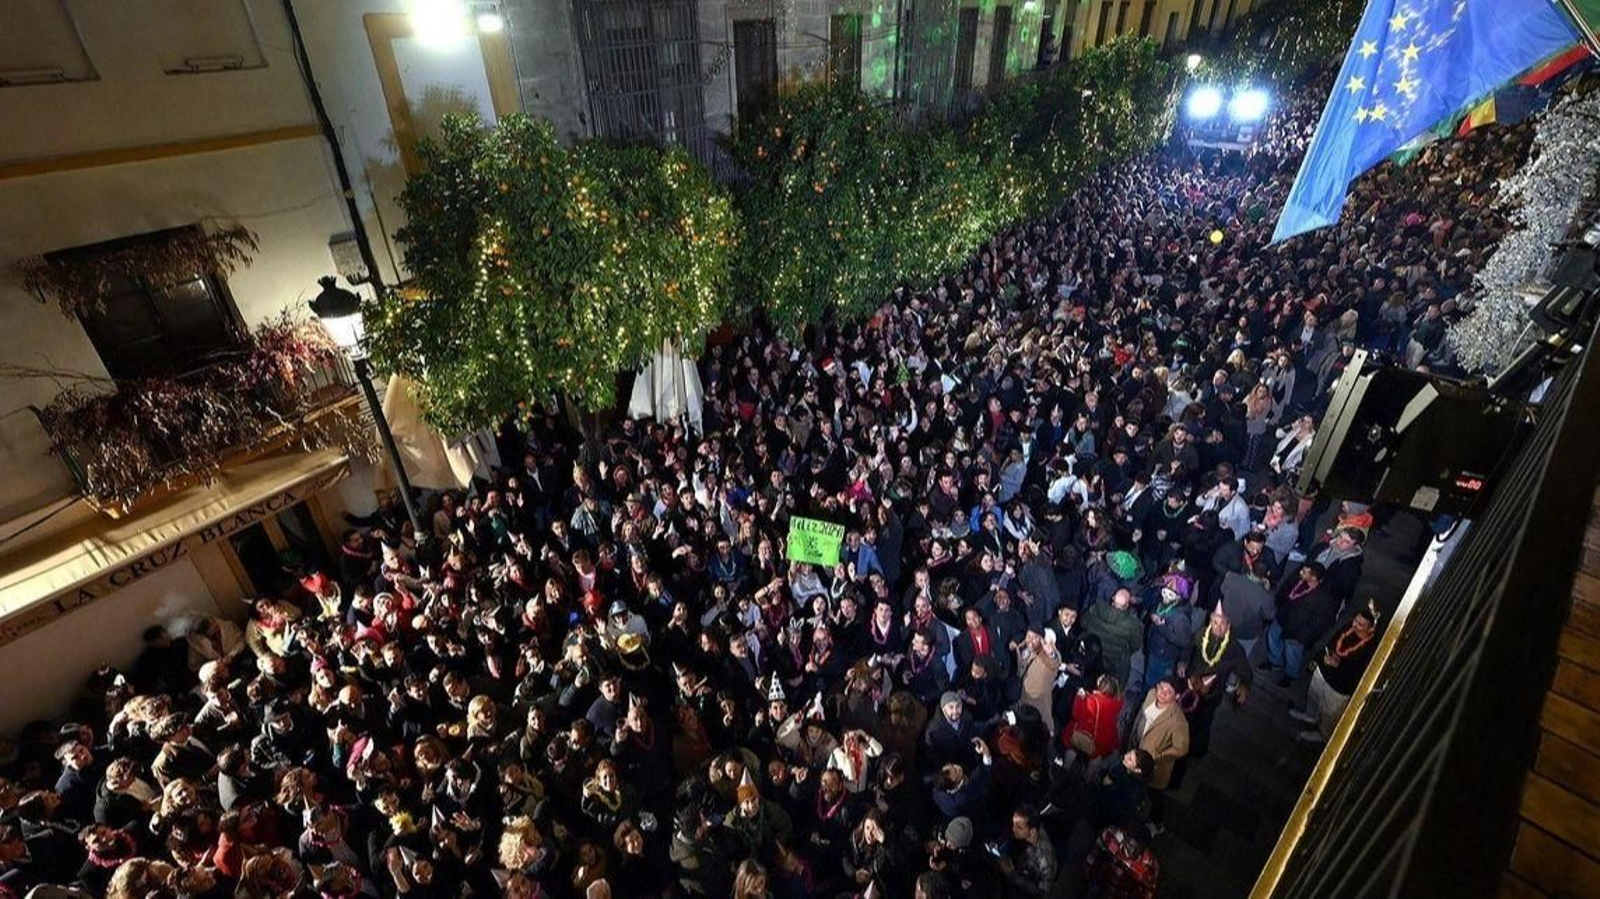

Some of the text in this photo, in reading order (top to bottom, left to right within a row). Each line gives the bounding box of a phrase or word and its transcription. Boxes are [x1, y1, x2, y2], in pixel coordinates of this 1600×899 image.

[51, 491, 296, 616] LA CRUZ BLANCA
